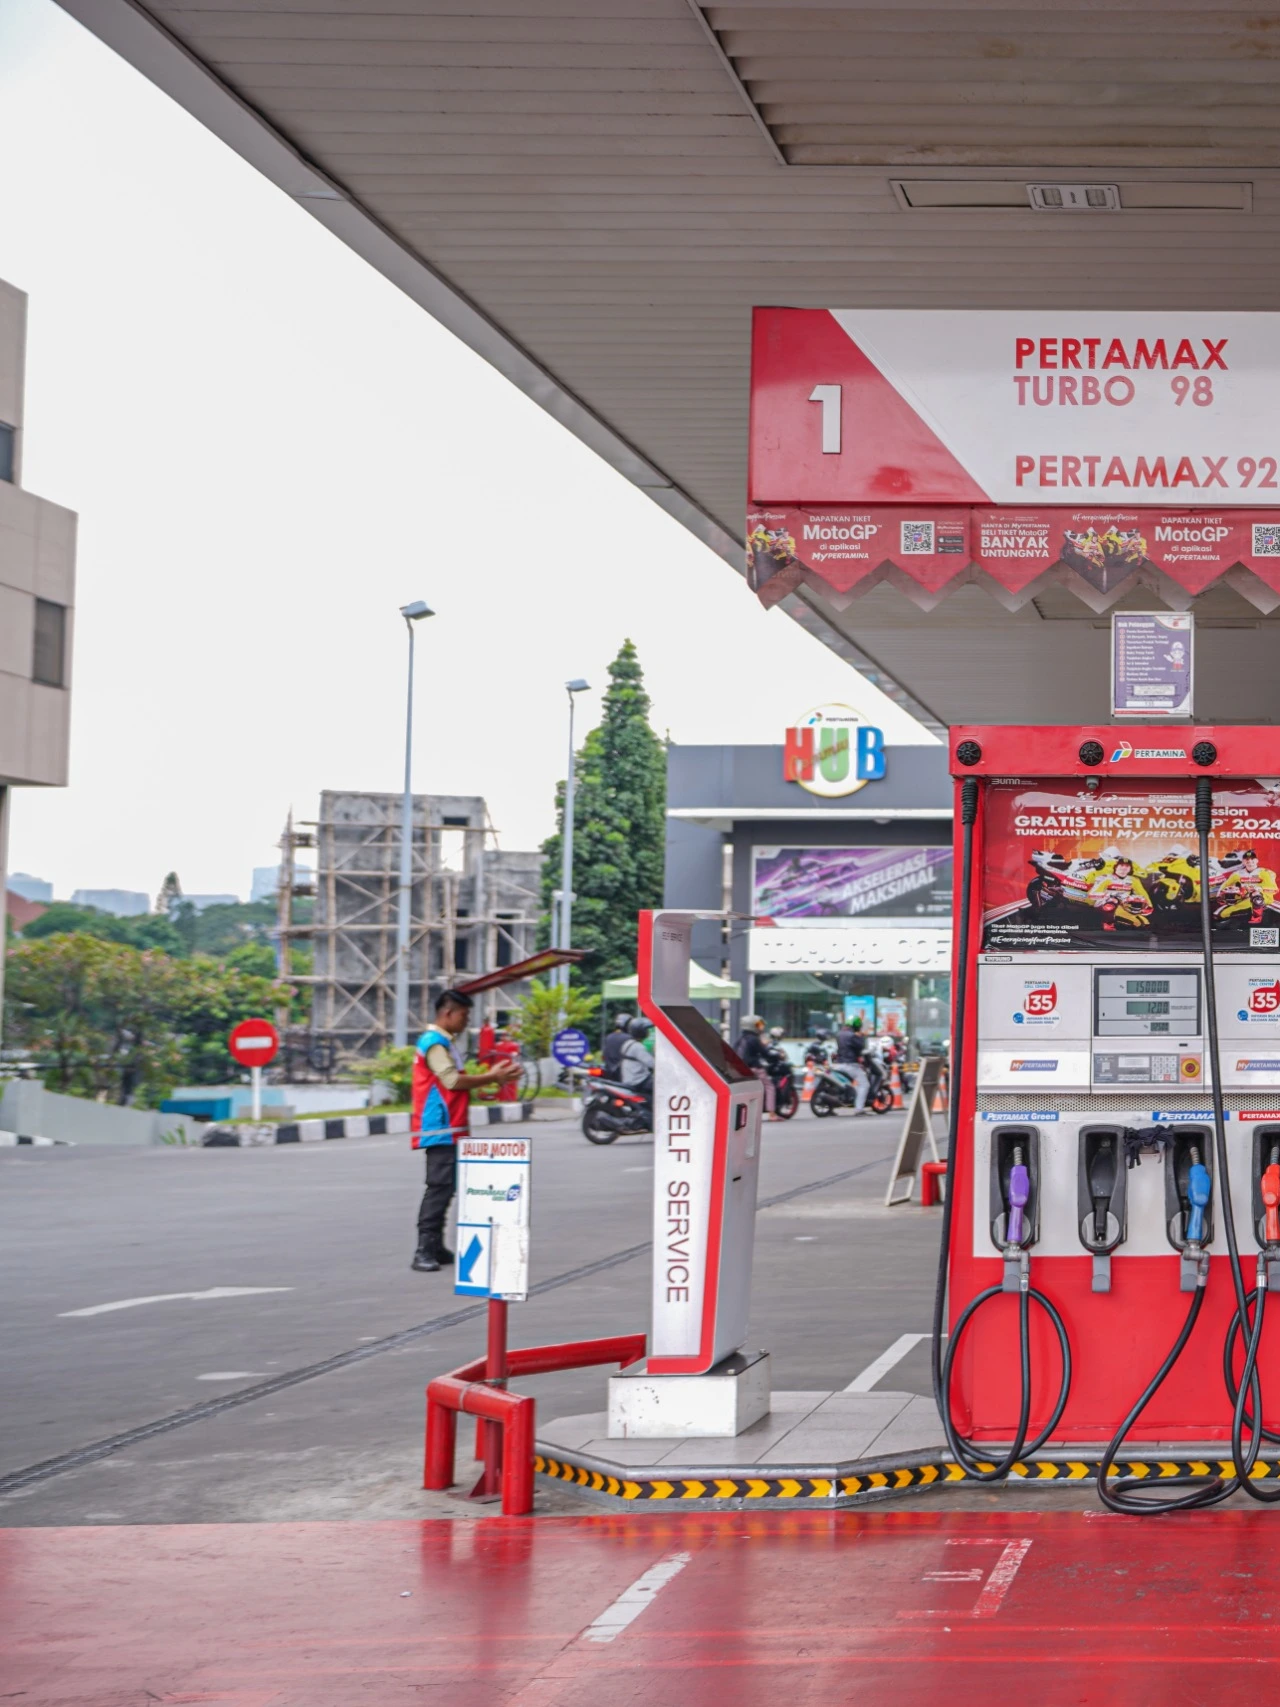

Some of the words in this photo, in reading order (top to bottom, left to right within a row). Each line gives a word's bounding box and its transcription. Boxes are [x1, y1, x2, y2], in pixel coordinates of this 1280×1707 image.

[1015, 338, 1229, 371] PERTAMAX
[1013, 375, 1135, 407] TURBO
[1170, 375, 1214, 407] 98
[808, 384, 842, 454] 1
[1015, 455, 1228, 489] PERTAMAX
[1237, 456, 1278, 489] 92
[829, 543, 861, 552] aplikasi
[981, 537, 1049, 548] BANYAK
[1181, 545, 1212, 553] aplikasi
[811, 552, 869, 562] MyPERTAMINA
[981, 549, 1049, 558] UNTUNGNYA
[1163, 554, 1220, 563] MyPERTAMINA
[784, 726, 886, 783] HUB
[1135, 750, 1186, 758] PERTAMINA
[1050, 805, 1082, 814] Let's
[1085, 805, 1149, 817] Energize
[1153, 807, 1189, 816] Your
[1014, 815, 1086, 828] GRATIS
[1091, 817, 1143, 828] TIKET
[1015, 828, 1080, 836] TUKARKAN
[1083, 829, 1112, 837] POIN
[842, 852, 928, 899] AKSELERASI
[850, 866, 937, 915] MAKSIMAL
[1025, 994, 1053, 1011] 135
[1250, 992, 1277, 1008] 135
[1030, 1112, 1056, 1120] Green
[1157, 1112, 1216, 1121] PERTAMA
[668, 1095, 691, 1163] SELF
[462, 1142, 489, 1156] JALUR
[492, 1143, 526, 1157] MOTOR
[508, 1188, 520, 1199] 95
[666, 1180, 690, 1303] SERVICE
